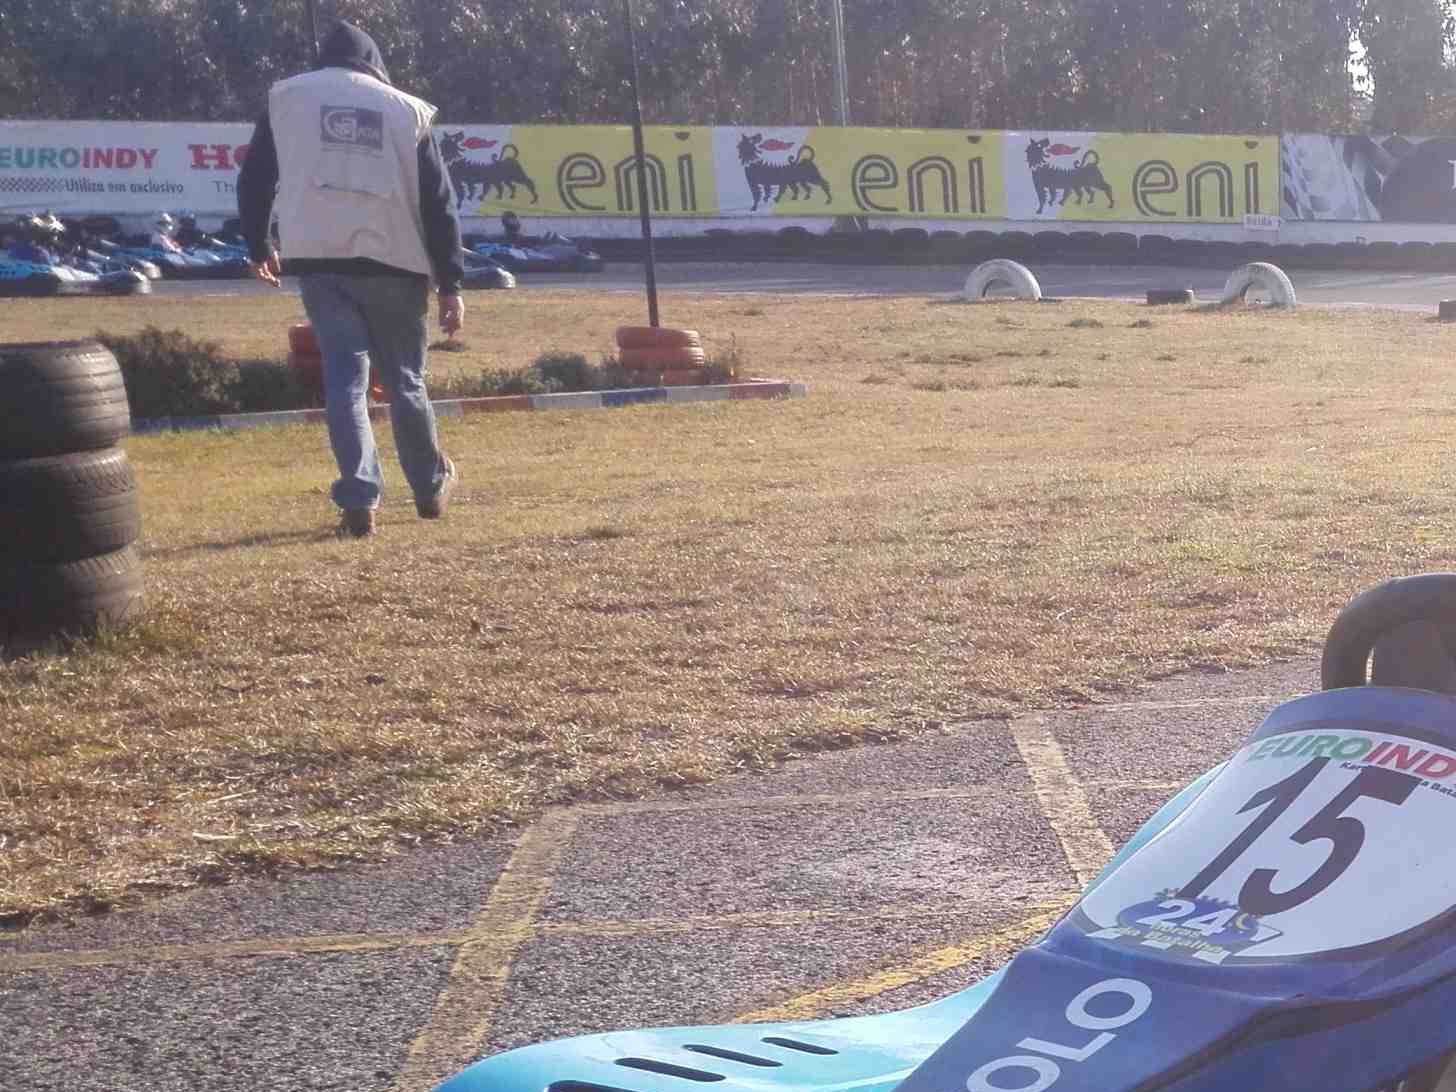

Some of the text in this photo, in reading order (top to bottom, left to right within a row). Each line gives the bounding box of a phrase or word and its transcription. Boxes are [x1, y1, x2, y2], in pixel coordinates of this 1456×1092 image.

[0, 144, 159, 169] EUROINDY
[556, 131, 697, 211] eni
[851, 135, 985, 213] eni
[1132, 140, 1261, 217] eni
[1181, 755, 1422, 917] 15
[1136, 899, 1239, 937] 24
